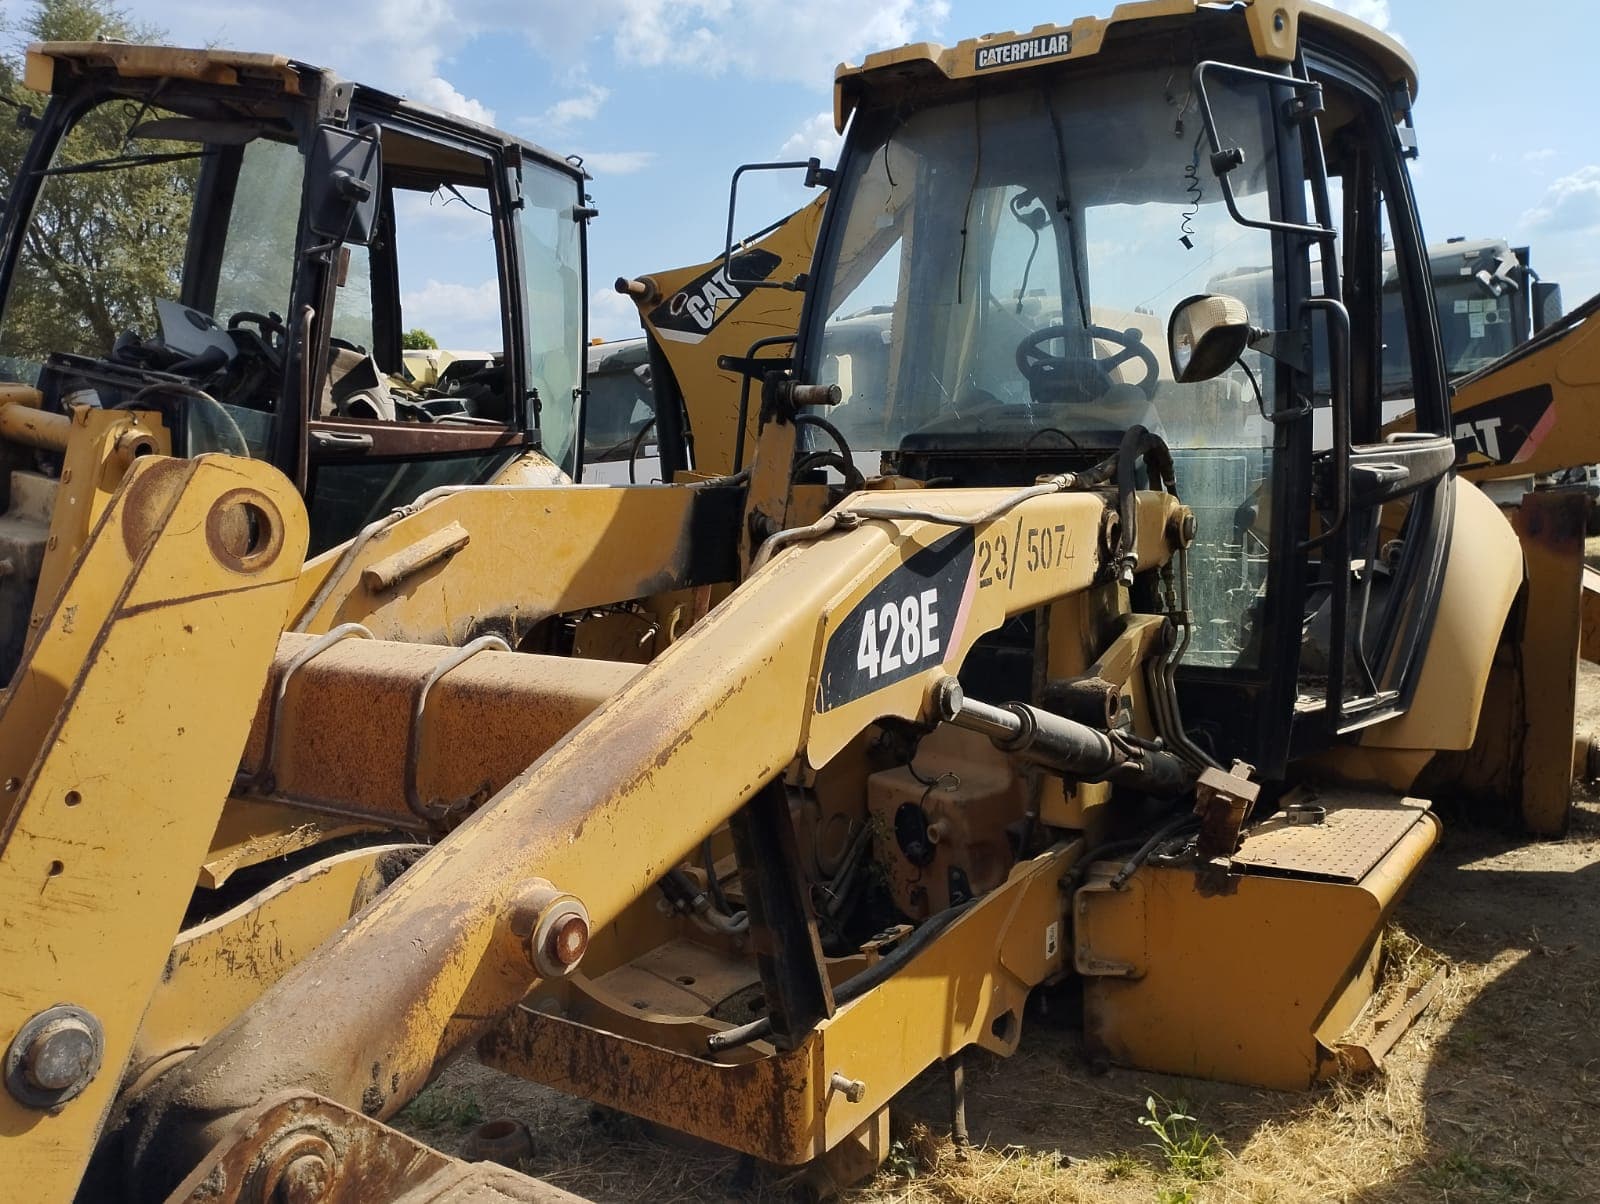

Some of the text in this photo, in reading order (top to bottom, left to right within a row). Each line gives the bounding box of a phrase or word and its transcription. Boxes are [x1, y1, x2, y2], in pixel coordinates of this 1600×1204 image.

[979, 35, 1068, 67] CATERPILLAR
[686, 266, 742, 329] CAT
[1455, 417, 1502, 461] AT
[857, 588, 940, 679] 428E
